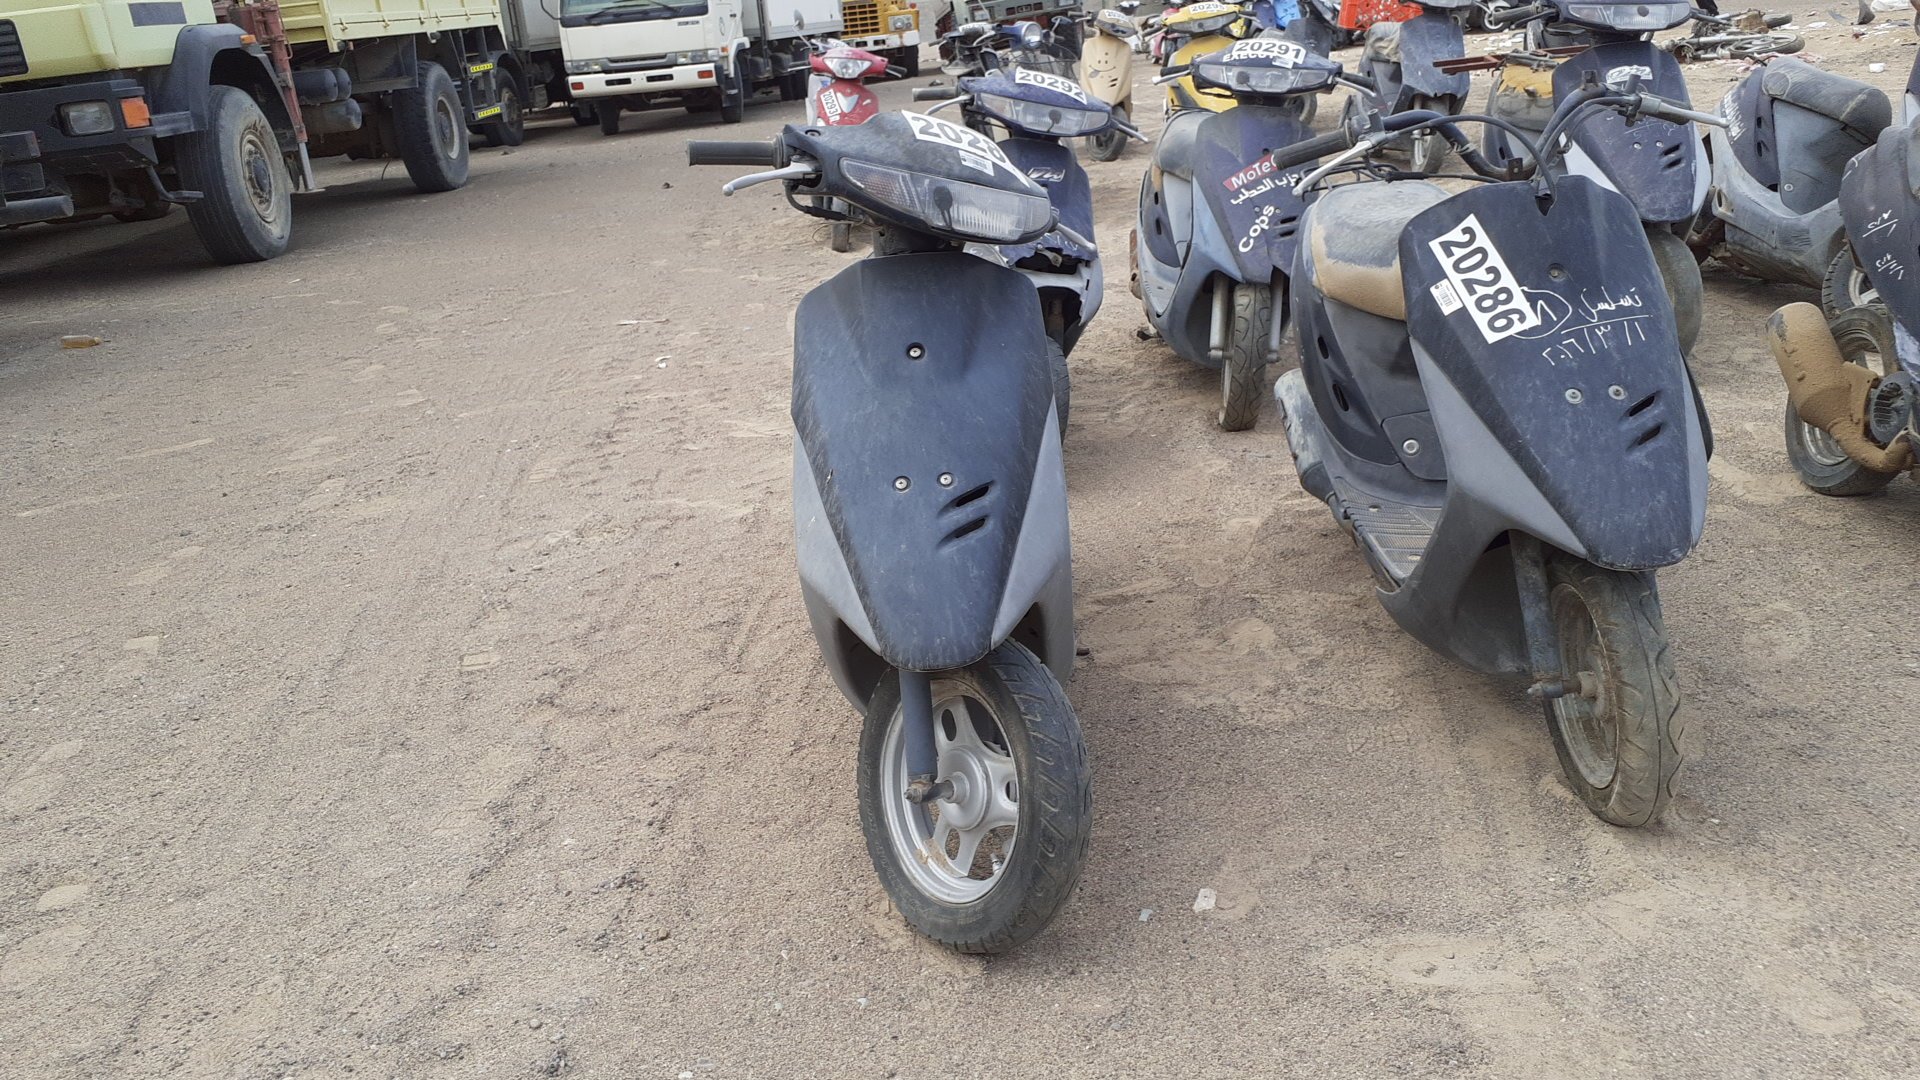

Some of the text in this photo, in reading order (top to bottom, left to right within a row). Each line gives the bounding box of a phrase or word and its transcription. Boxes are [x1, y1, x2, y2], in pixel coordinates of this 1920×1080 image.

[1235, 41, 1302, 60] 20291
[822, 91, 839, 114] 20293
[1018, 71, 1085, 100] 20292
[911, 115, 1010, 166] 2028
[1238, 204, 1275, 253] Cops
[1439, 225, 1527, 334] 20286
